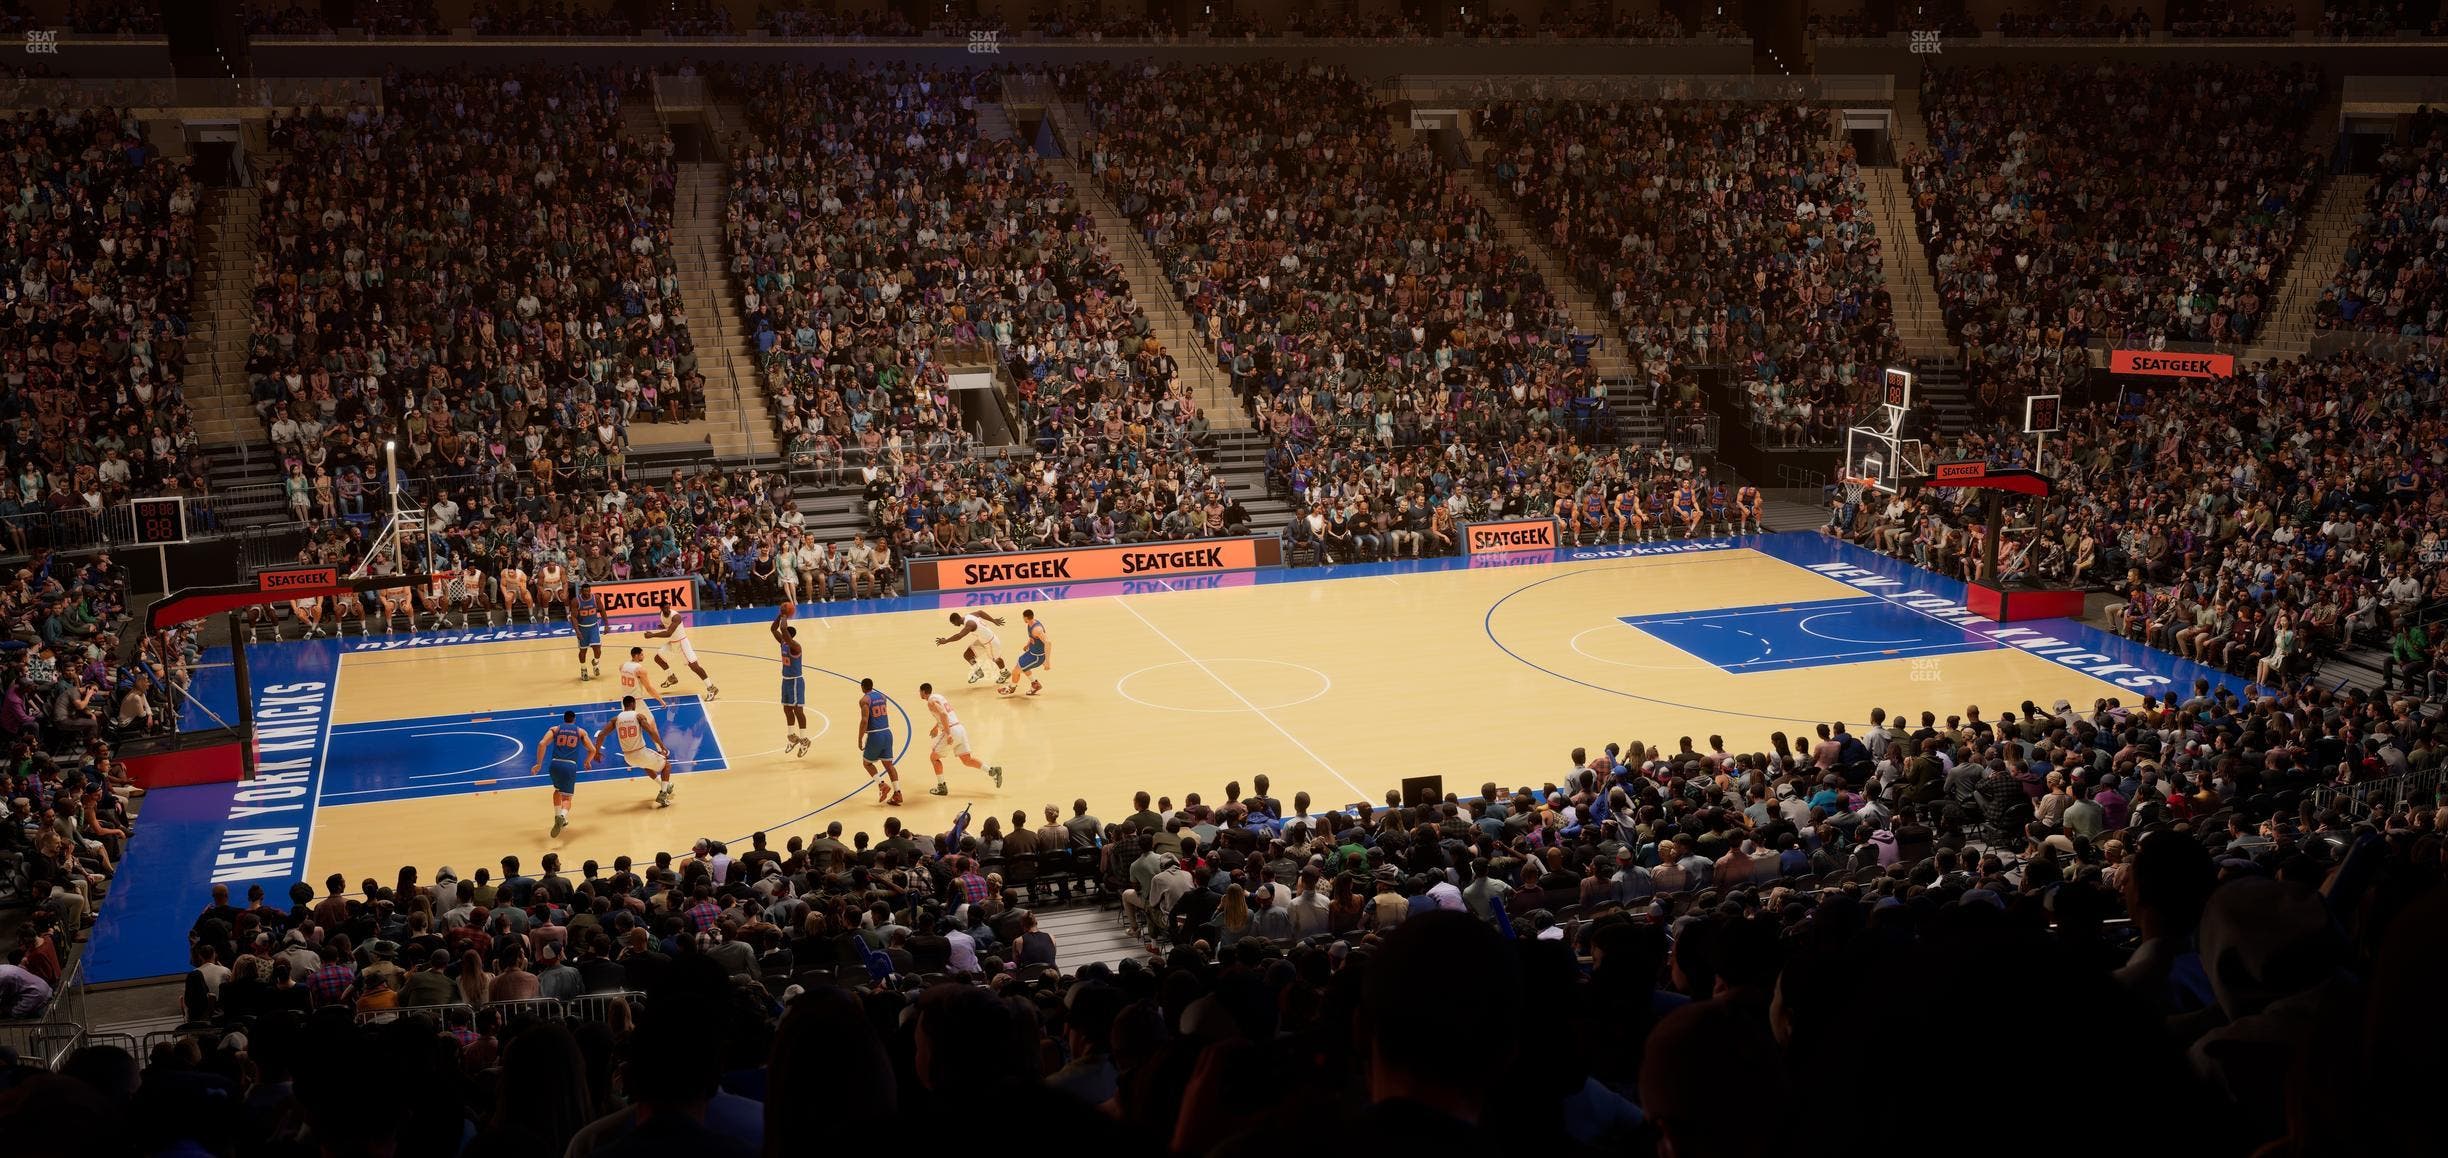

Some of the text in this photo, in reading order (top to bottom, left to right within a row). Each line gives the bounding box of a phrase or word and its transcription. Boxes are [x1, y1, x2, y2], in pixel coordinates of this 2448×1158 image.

[2131, 357, 2214, 374] SEATGEEK
[1942, 465, 1980, 476] SEATGEEK
[1475, 527, 1550, 549] SEATGEEK
[1572, 542, 1731, 560] @nyknicks
[964, 546, 1224, 585] SEATGEEK SEATGEEK
[267, 571, 329, 587] SEATGEEK
[1805, 562, 2172, 687] NEW YORK KNICKS
[355, 622, 633, 650] nyknicks.cm
[618, 725, 637, 739] 00
[556, 735, 578, 748] 00
[210, 681, 326, 884] NEW YORK KNICKS
